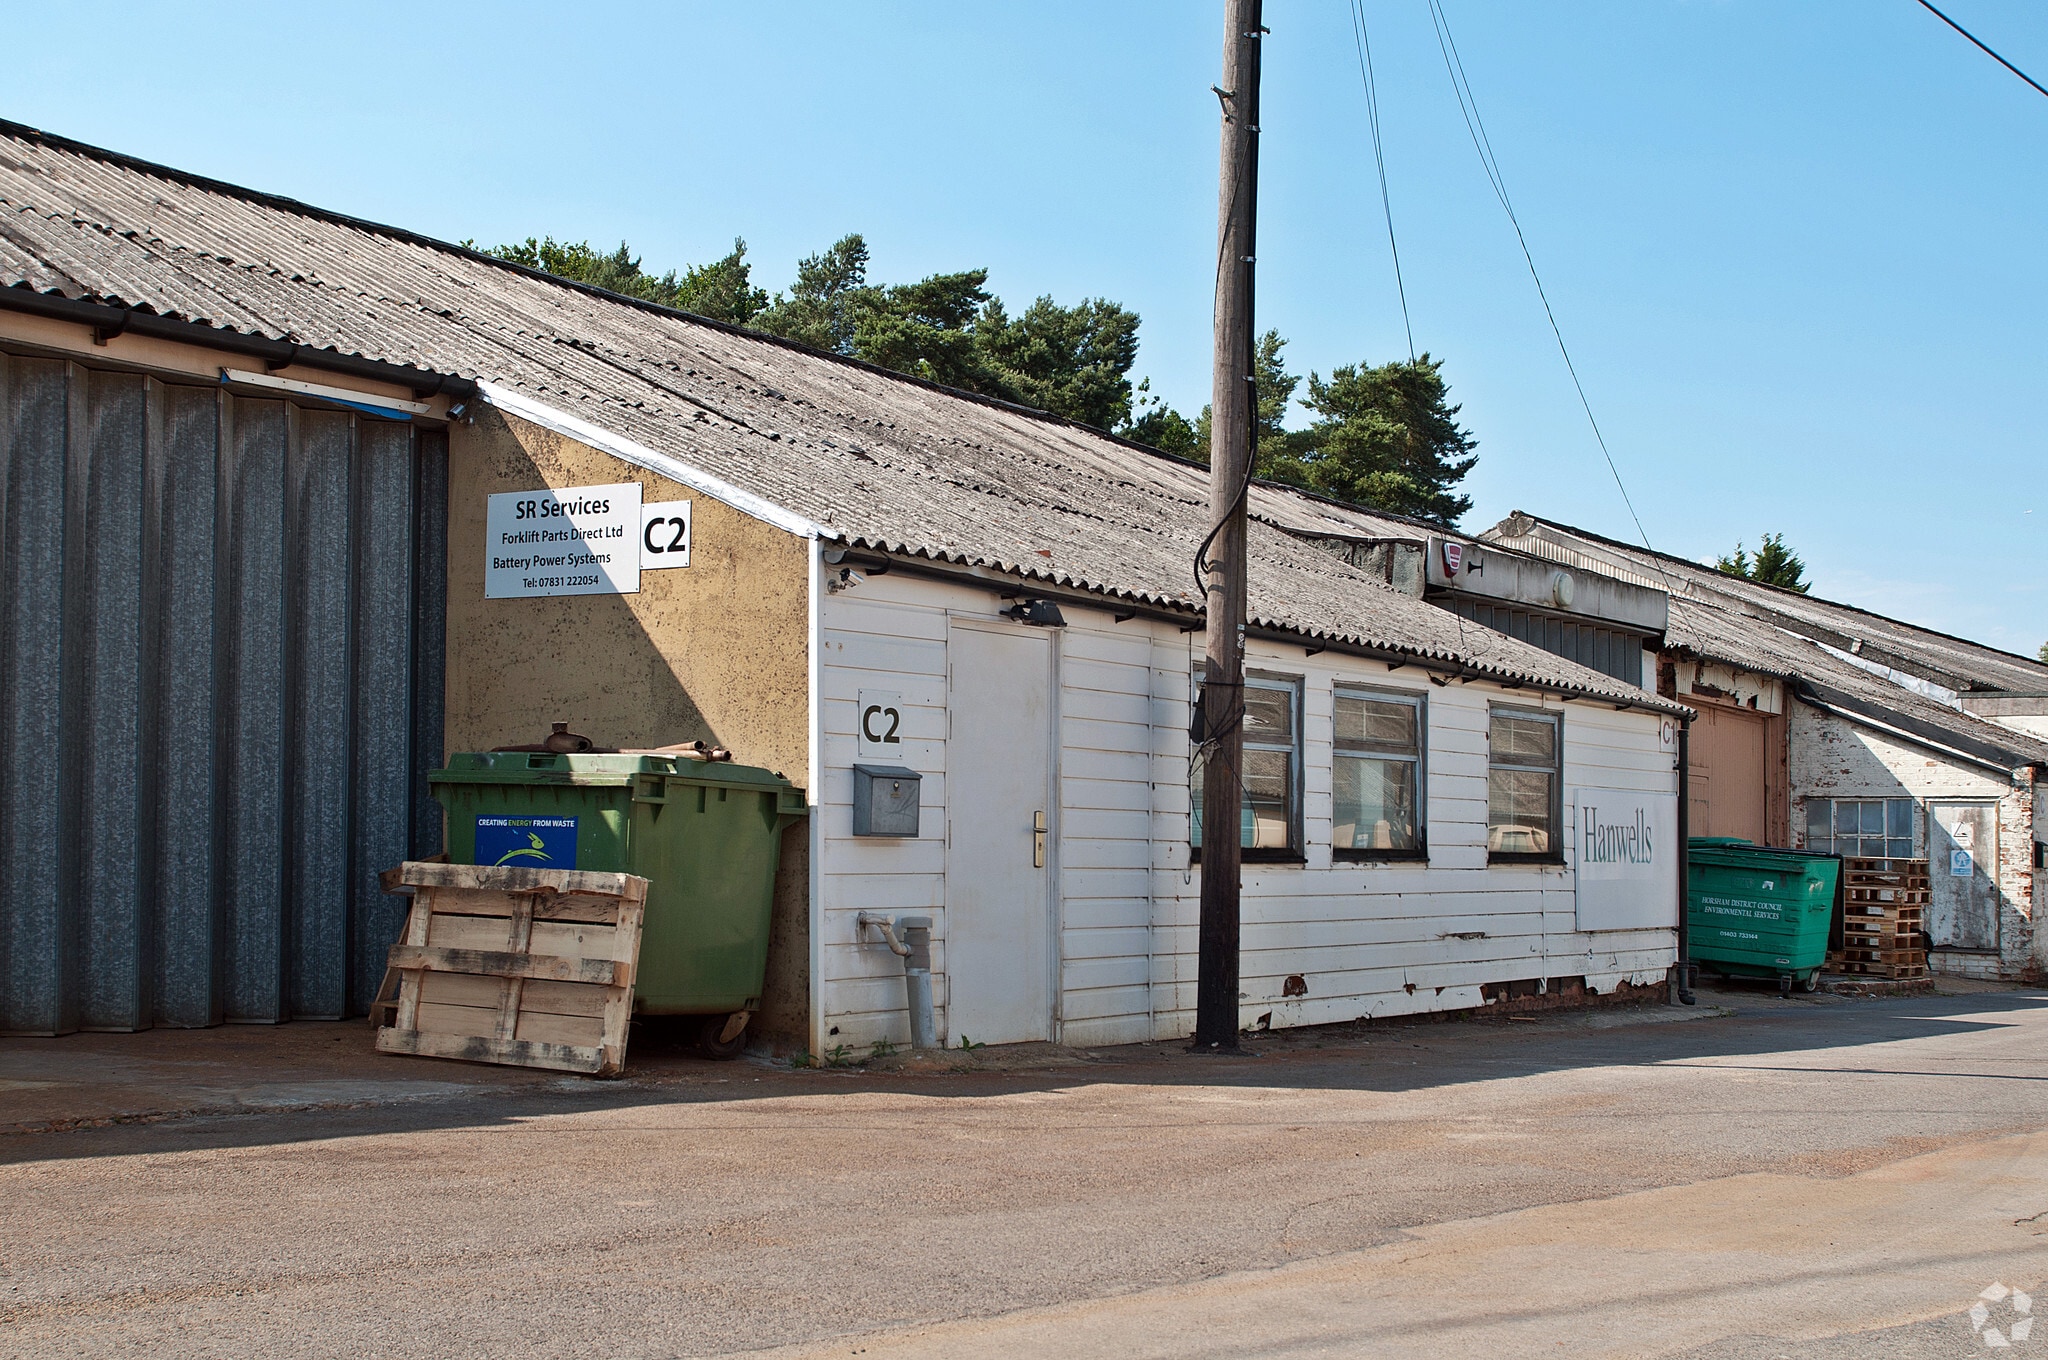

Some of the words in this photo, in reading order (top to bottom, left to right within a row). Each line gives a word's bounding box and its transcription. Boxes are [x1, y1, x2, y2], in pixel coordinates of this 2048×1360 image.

[515, 500, 537, 520] SR
[540, 496, 610, 518] Services
[502, 530, 540, 545] Forklift
[541, 529, 568, 543] Parts
[571, 526, 603, 541] Direct
[605, 524, 623, 538] Ltd
[644, 517, 686, 554] C2
[493, 554, 531, 572] Battery
[533, 553, 566, 568] Power
[567, 552, 611, 568] Systems
[522, 577, 538, 588] Tel:
[538, 576, 565, 588] 07831
[566, 575, 599, 586] 222054
[862, 704, 900, 744] C2
[1662, 720, 1675, 745] C1
[508, 819, 533, 827] ENERGY
[552, 820, 575, 828] WASTE
[1582, 806, 1652, 864] Hanwells
[1702, 897, 1730, 906] HORSHAM
[1731, 899, 1757, 909] DISTRICT
[1758, 902, 1782, 911] COUNCIL
[1704, 906, 1752, 917] ENVIRONMENTAL
[1754, 911, 1779, 919] SERVICES
